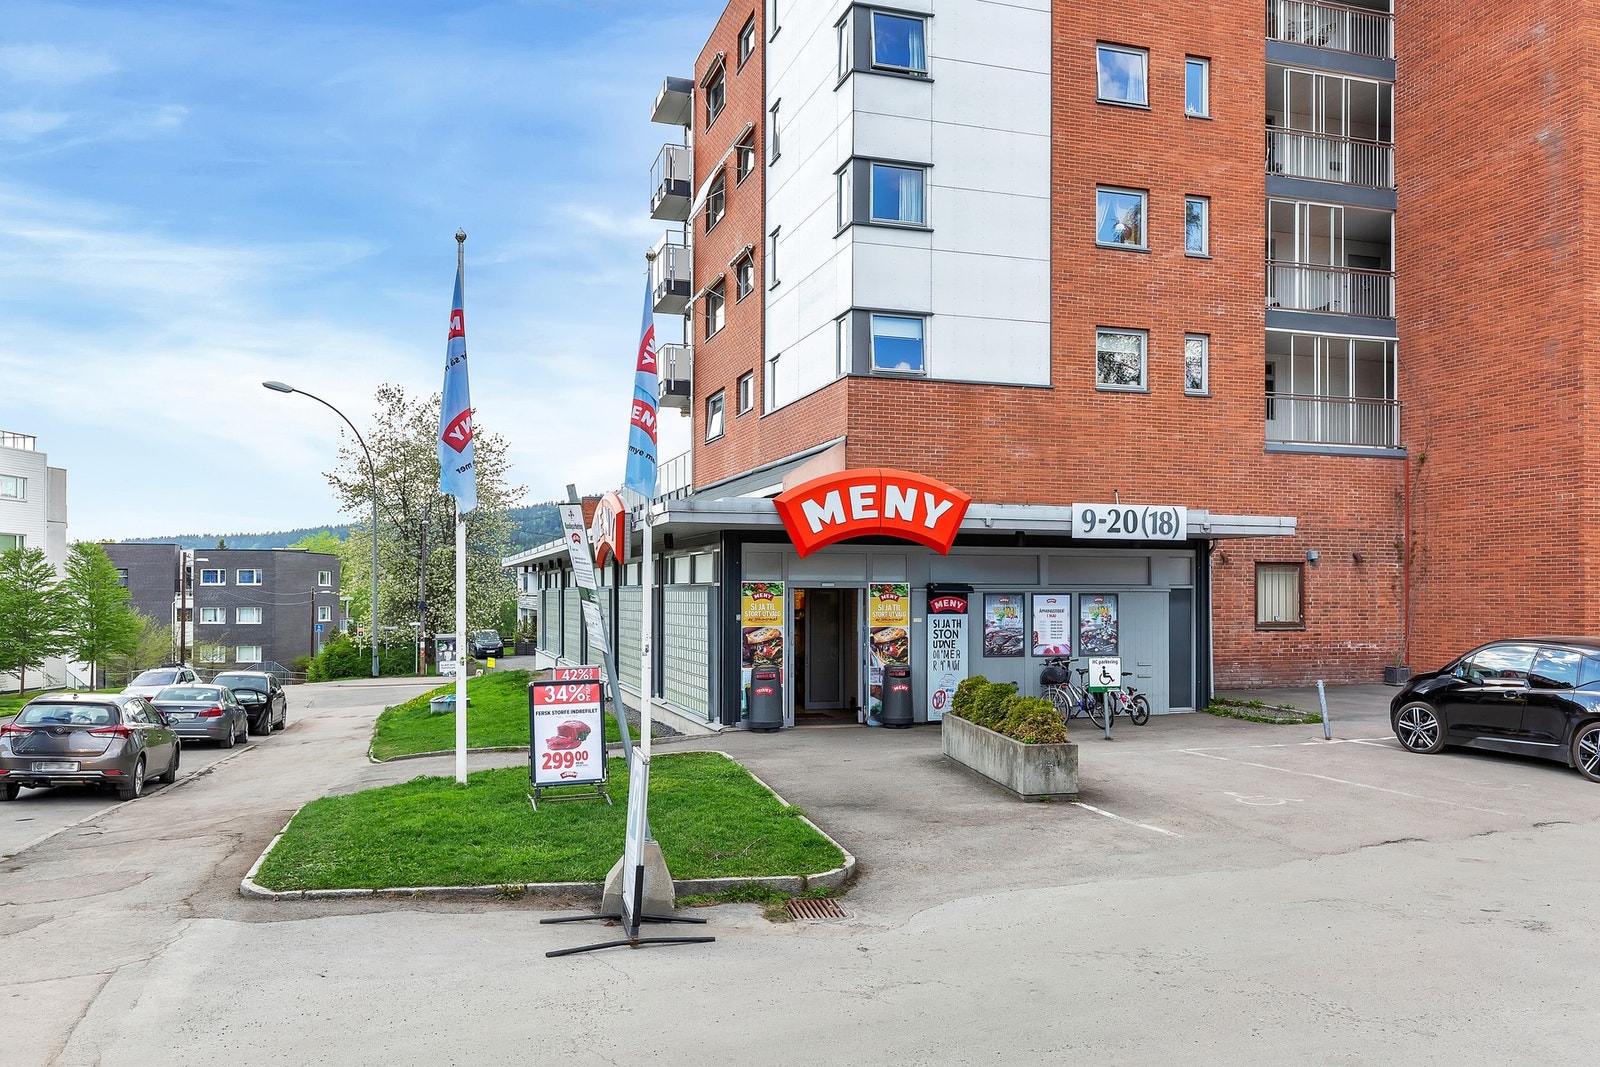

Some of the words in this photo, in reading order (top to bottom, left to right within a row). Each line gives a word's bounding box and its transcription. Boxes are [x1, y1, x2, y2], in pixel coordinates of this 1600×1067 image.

[628, 445, 644, 457] mye
[801, 484, 954, 534] MENY
[1081, 506, 1180, 539] 9-20(18)
[750, 603, 757, 611] SI
[758, 603, 766, 611] JA
[934, 599, 964, 609] MENY
[933, 619, 940, 629] SI
[942, 619, 951, 629] JA
[562, 668, 589, 680] 42%
[544, 684, 586, 703] 34%
[542, 751, 574, 770] 299
[575, 750, 589, 761] 00
